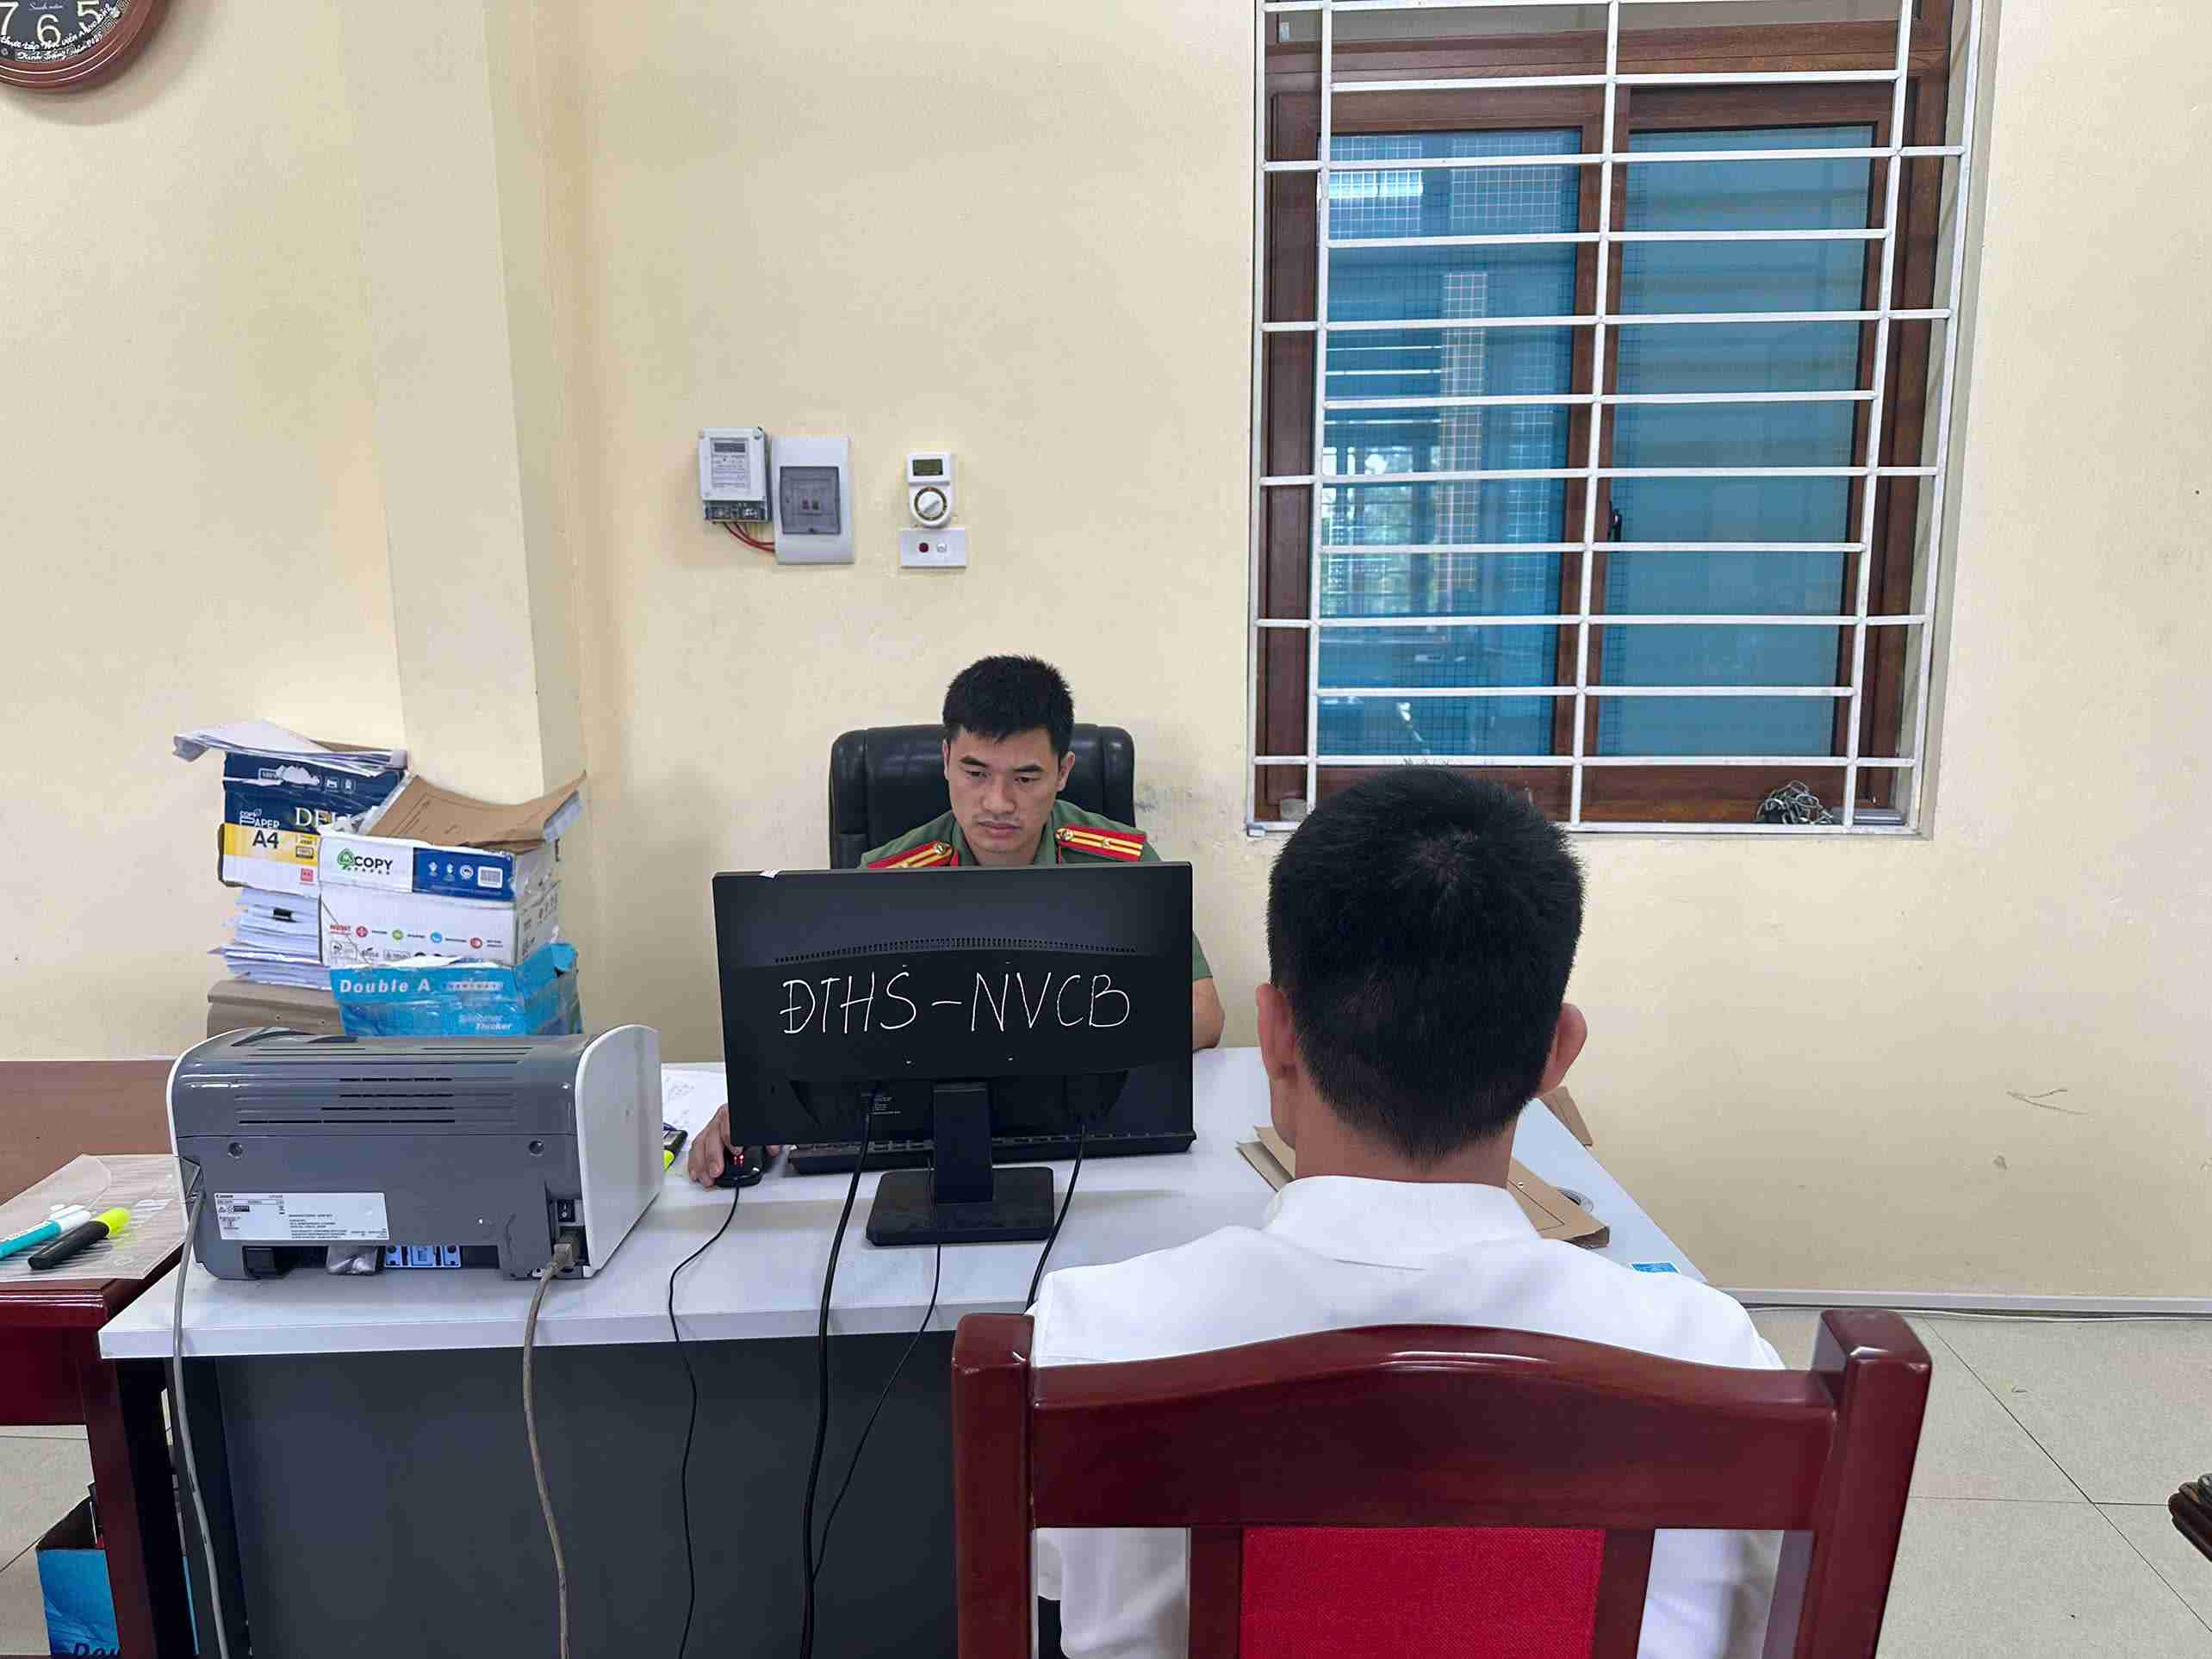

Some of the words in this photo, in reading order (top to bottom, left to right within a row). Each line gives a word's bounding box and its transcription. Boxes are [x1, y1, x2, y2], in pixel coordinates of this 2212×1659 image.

[0, 1, 19, 36] 7
[36, 14, 61, 45] 6
[77, 1, 101, 33] 5
[295, 806, 353, 827] DE
[252, 830, 279, 848] A4
[353, 855, 394, 870] COPY
[340, 979, 409, 993] Double
[418, 978, 432, 992] A
[972, 972, 1130, 1032] NVCB
